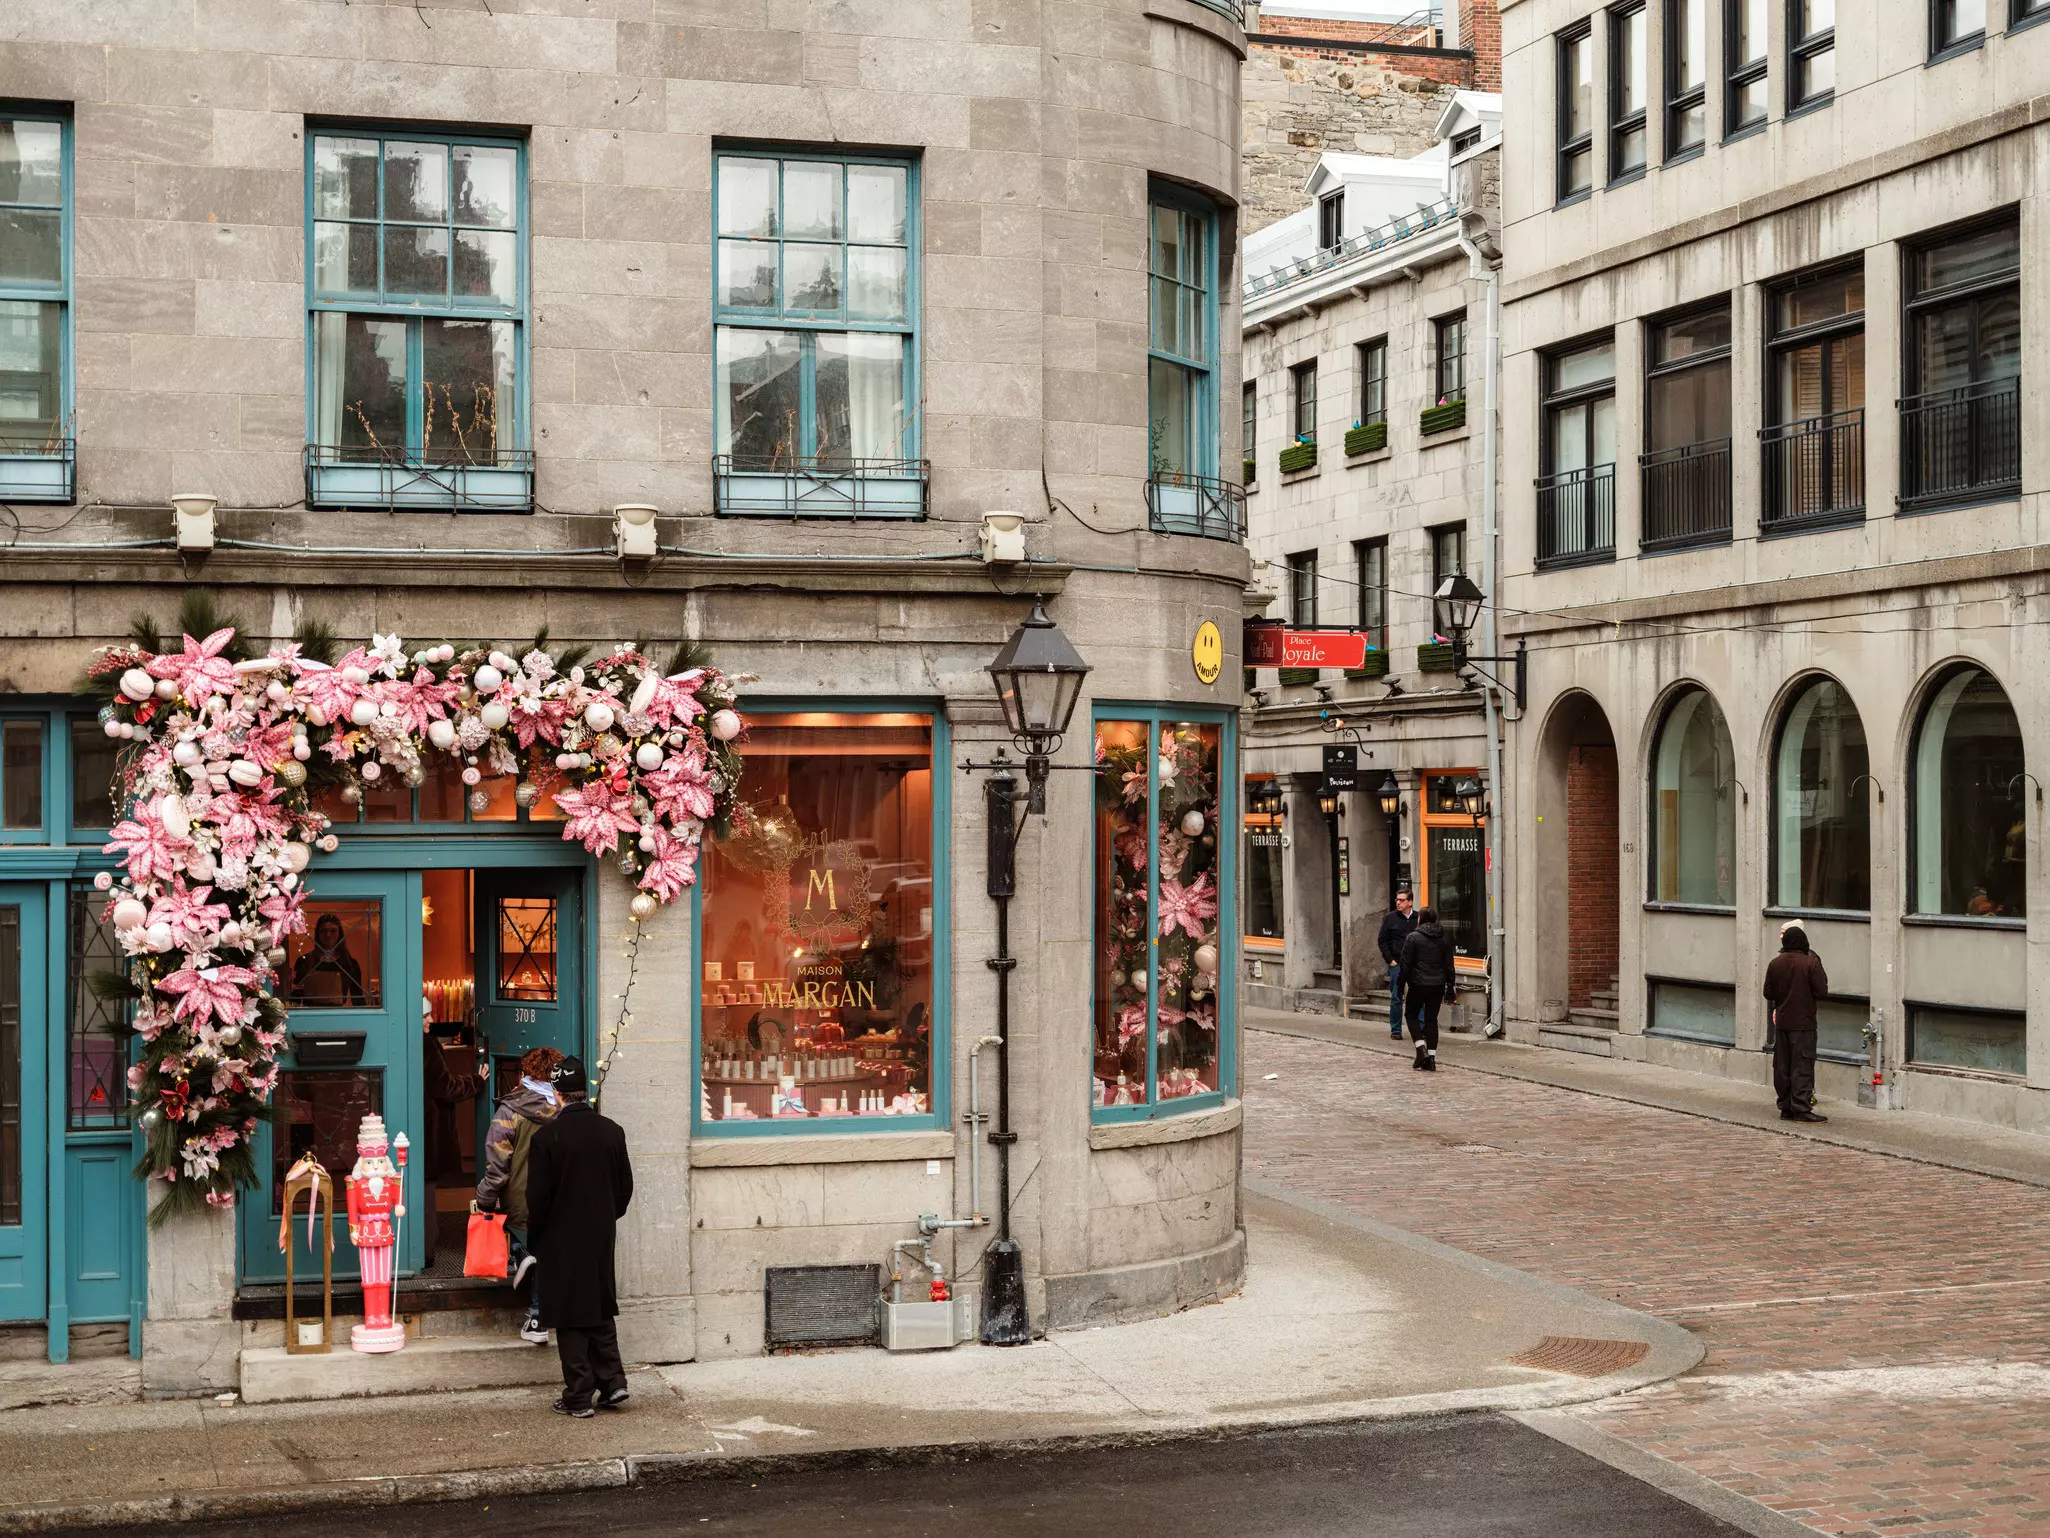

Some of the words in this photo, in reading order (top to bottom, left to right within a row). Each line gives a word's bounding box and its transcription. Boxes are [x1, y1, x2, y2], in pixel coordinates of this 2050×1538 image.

[1290, 636, 1312, 645] Place
[1283, 646, 1325, 665] oyale
[1196, 663, 1218, 678] AMOUR
[1252, 835, 1279, 847] TERRASSE
[1443, 838, 1478, 851] TERRASSE
[804, 869, 838, 910] M
[797, 966, 843, 976] MAISON
[761, 981, 877, 1010] MARGAN
[515, 1008, 529, 1022] 370
